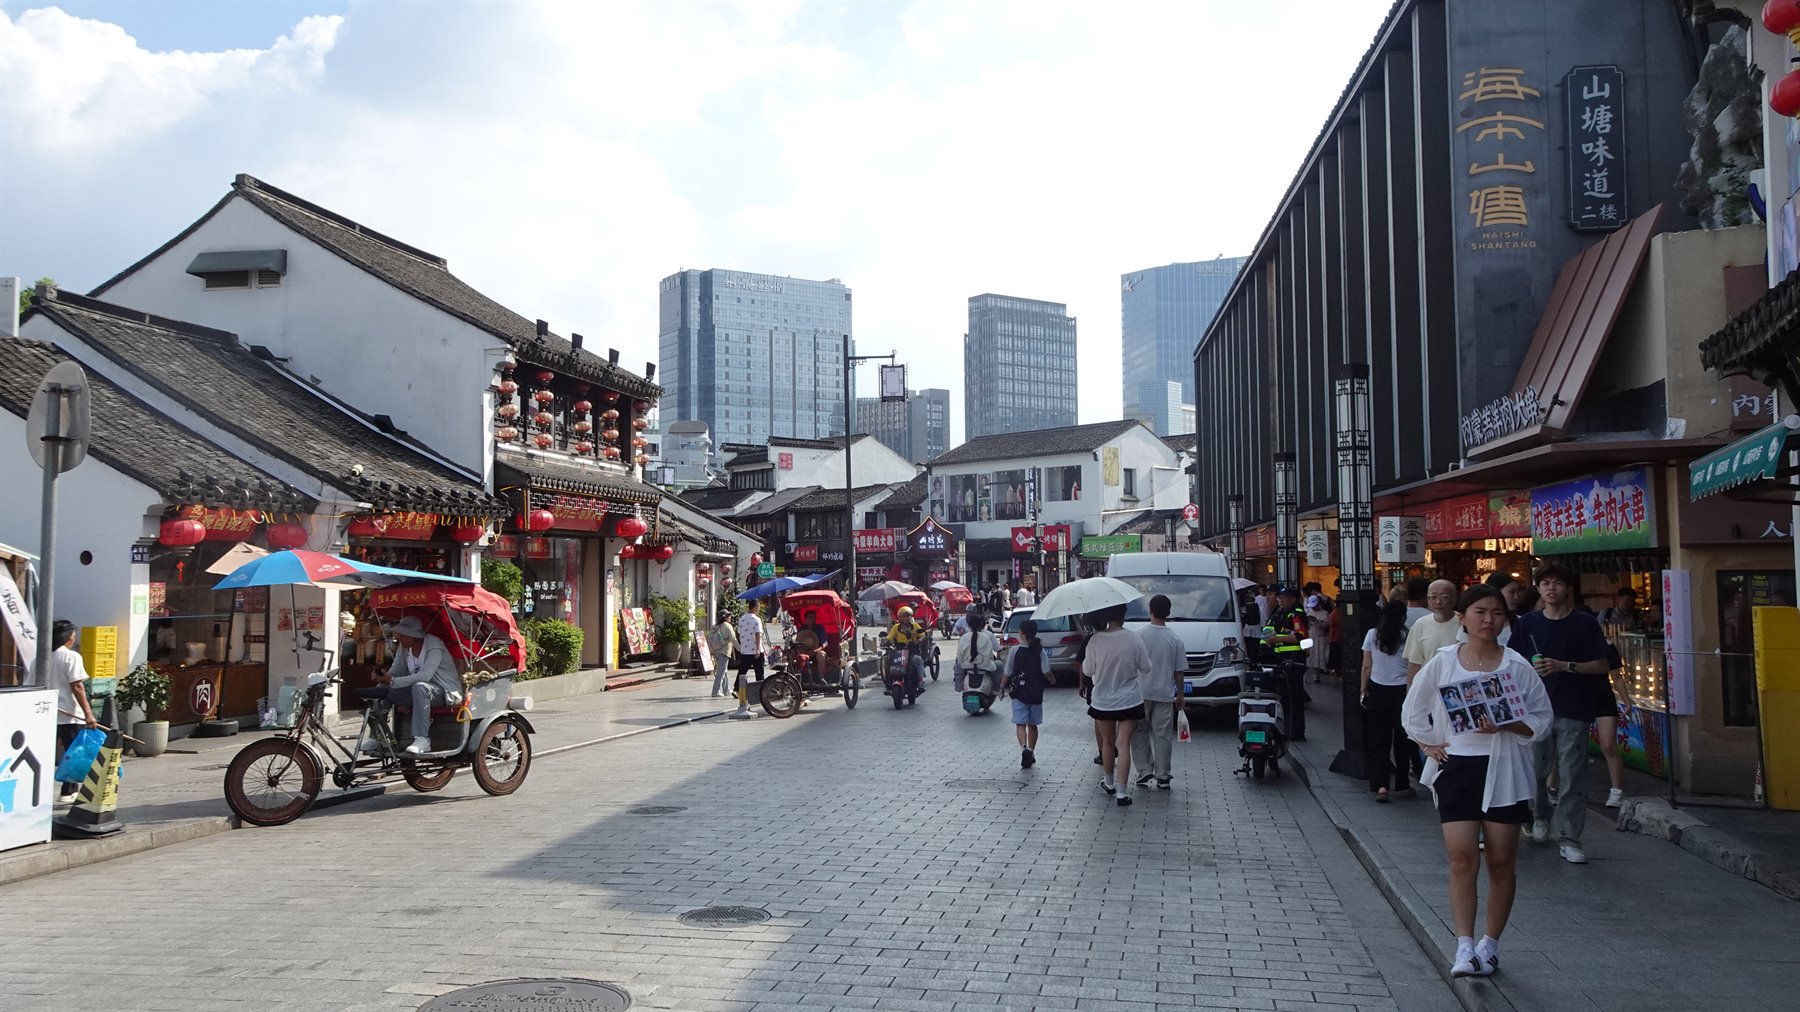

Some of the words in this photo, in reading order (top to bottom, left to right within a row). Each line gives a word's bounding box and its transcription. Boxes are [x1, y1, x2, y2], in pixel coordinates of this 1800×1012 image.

[1581, 75, 1615, 199] 山塘味道
[1581, 204, 1617, 220] 二楼
[1471, 240, 1537, 250] SHANTANG
[1482, 231, 1524, 239] HAISHI
[1534, 496, 1587, 541] 内蒙古羔羊
[1593, 486, 1645, 536] 牛肉大串
[196, 679, 211, 710] 肉
